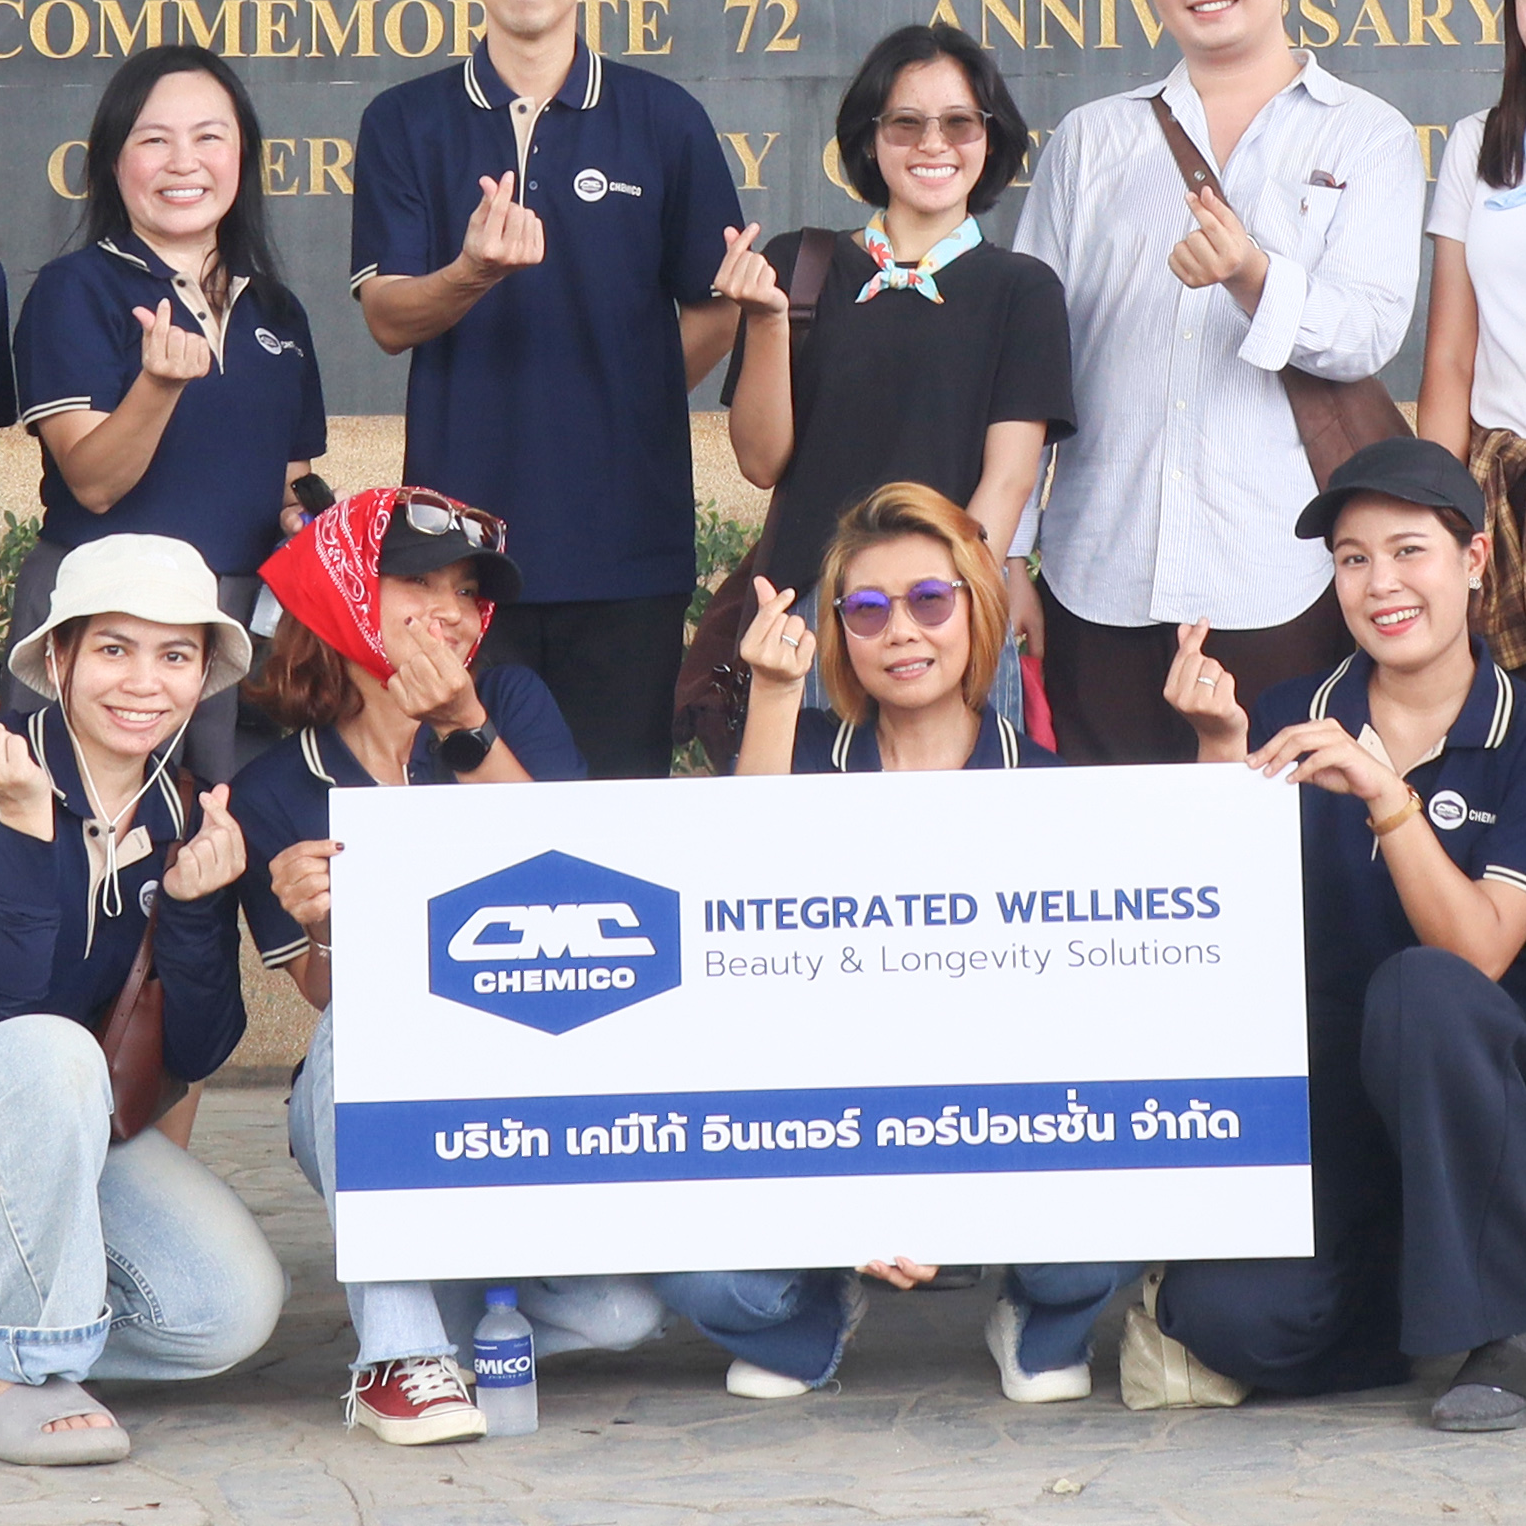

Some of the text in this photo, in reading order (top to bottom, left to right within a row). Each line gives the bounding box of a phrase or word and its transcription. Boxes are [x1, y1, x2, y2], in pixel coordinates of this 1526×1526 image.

[447, 901, 656, 962] CMC
[705, 886, 1221, 933] INTEGRATED WELLNESS
[473, 967, 636, 994] CHEMICO
[705, 937, 1221, 981] Beauty & Longevity Solutions
[435, 1088, 1241, 1160] บริษัท เคมีโก้ อินเตอร์ คอร์ปอเรชั่น จำกัด
[474, 1356, 531, 1375] EMICO
